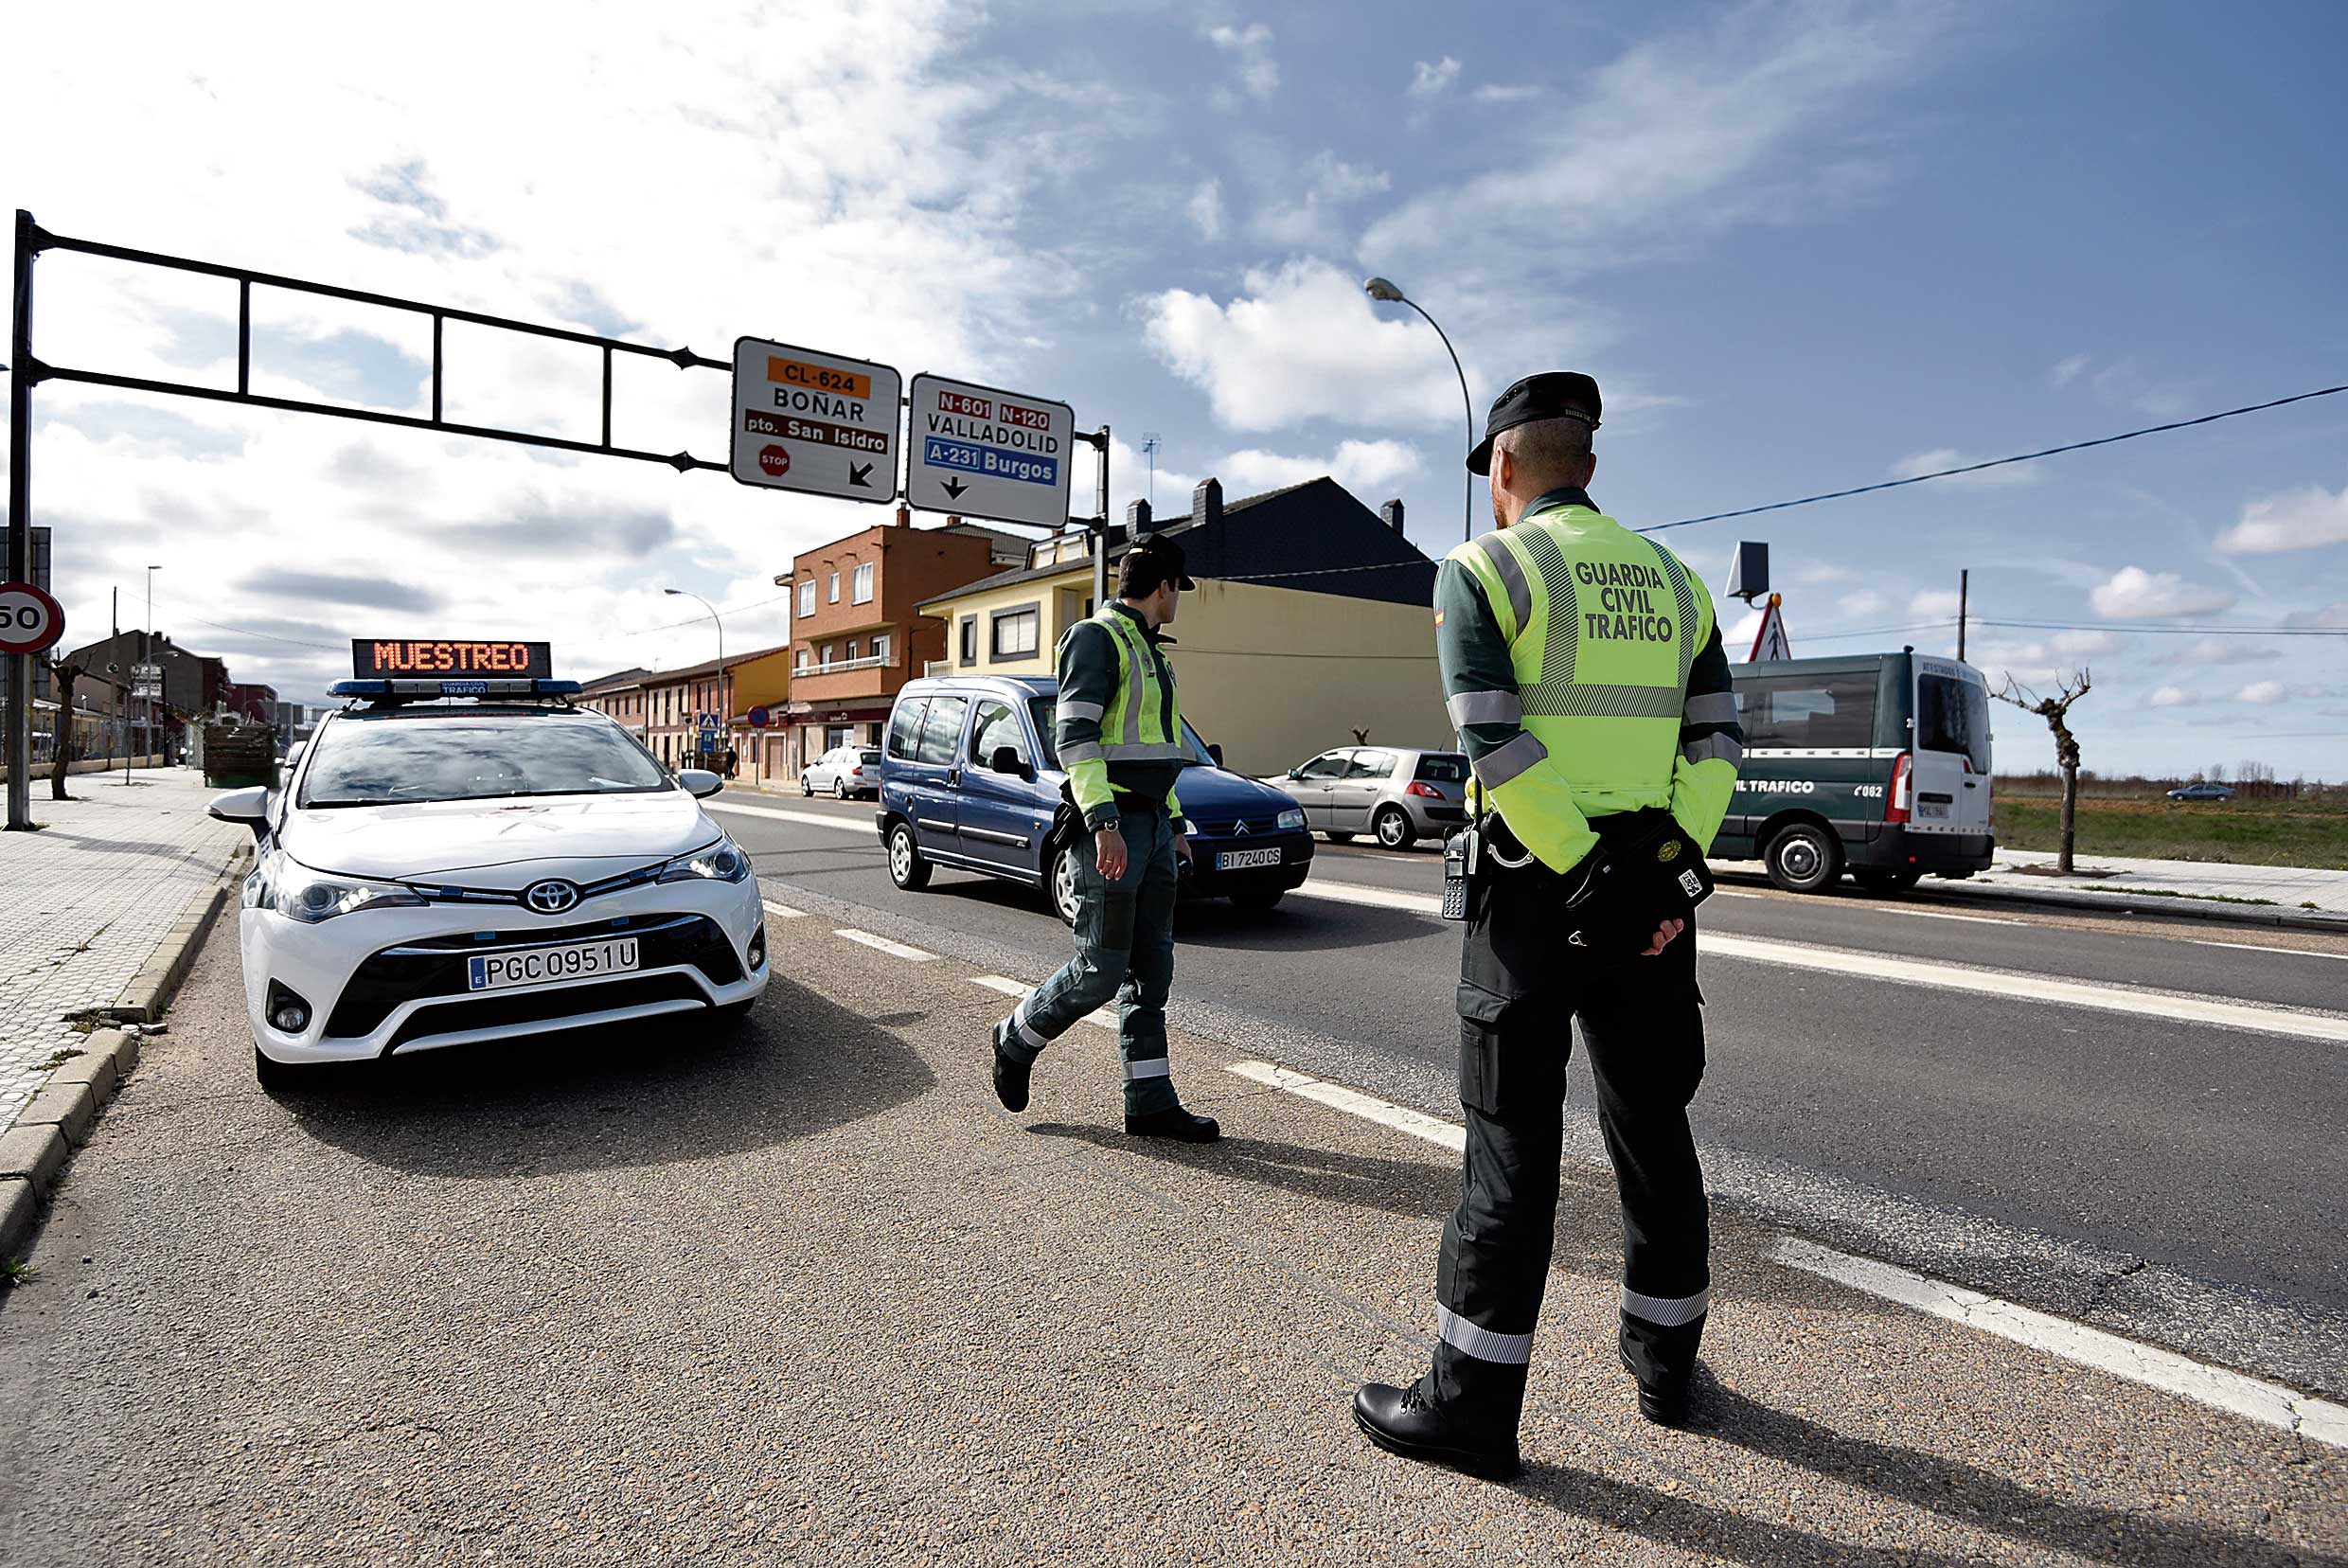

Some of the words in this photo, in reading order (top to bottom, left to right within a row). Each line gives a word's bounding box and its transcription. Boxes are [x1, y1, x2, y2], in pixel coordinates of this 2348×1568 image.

[785, 364, 855, 392] CL-624
[774, 387, 863, 421] BOÑAR
[941, 393, 990, 418] N-601
[1001, 406, 1048, 428] N-120
[747, 418, 778, 433] pto.
[787, 420, 824, 440] San
[834, 428, 885, 451] Isidro
[928, 413, 1058, 454] VALLADOLID
[761, 454, 788, 466] STOP
[930, 444, 977, 466] A-231
[985, 452, 1053, 480] Burgos
[1575, 561, 1665, 590] GUARDIA
[1601, 587, 1655, 615] CIVIL
[1585, 614, 1673, 642] TRAFICO
[373, 643, 529, 670] MUESTREO
[1750, 780, 1815, 793] TRAFICO
[1222, 854, 1235, 867] BI
[1238, 850, 1265, 866] 7240
[1267, 849, 1280, 863] CS
